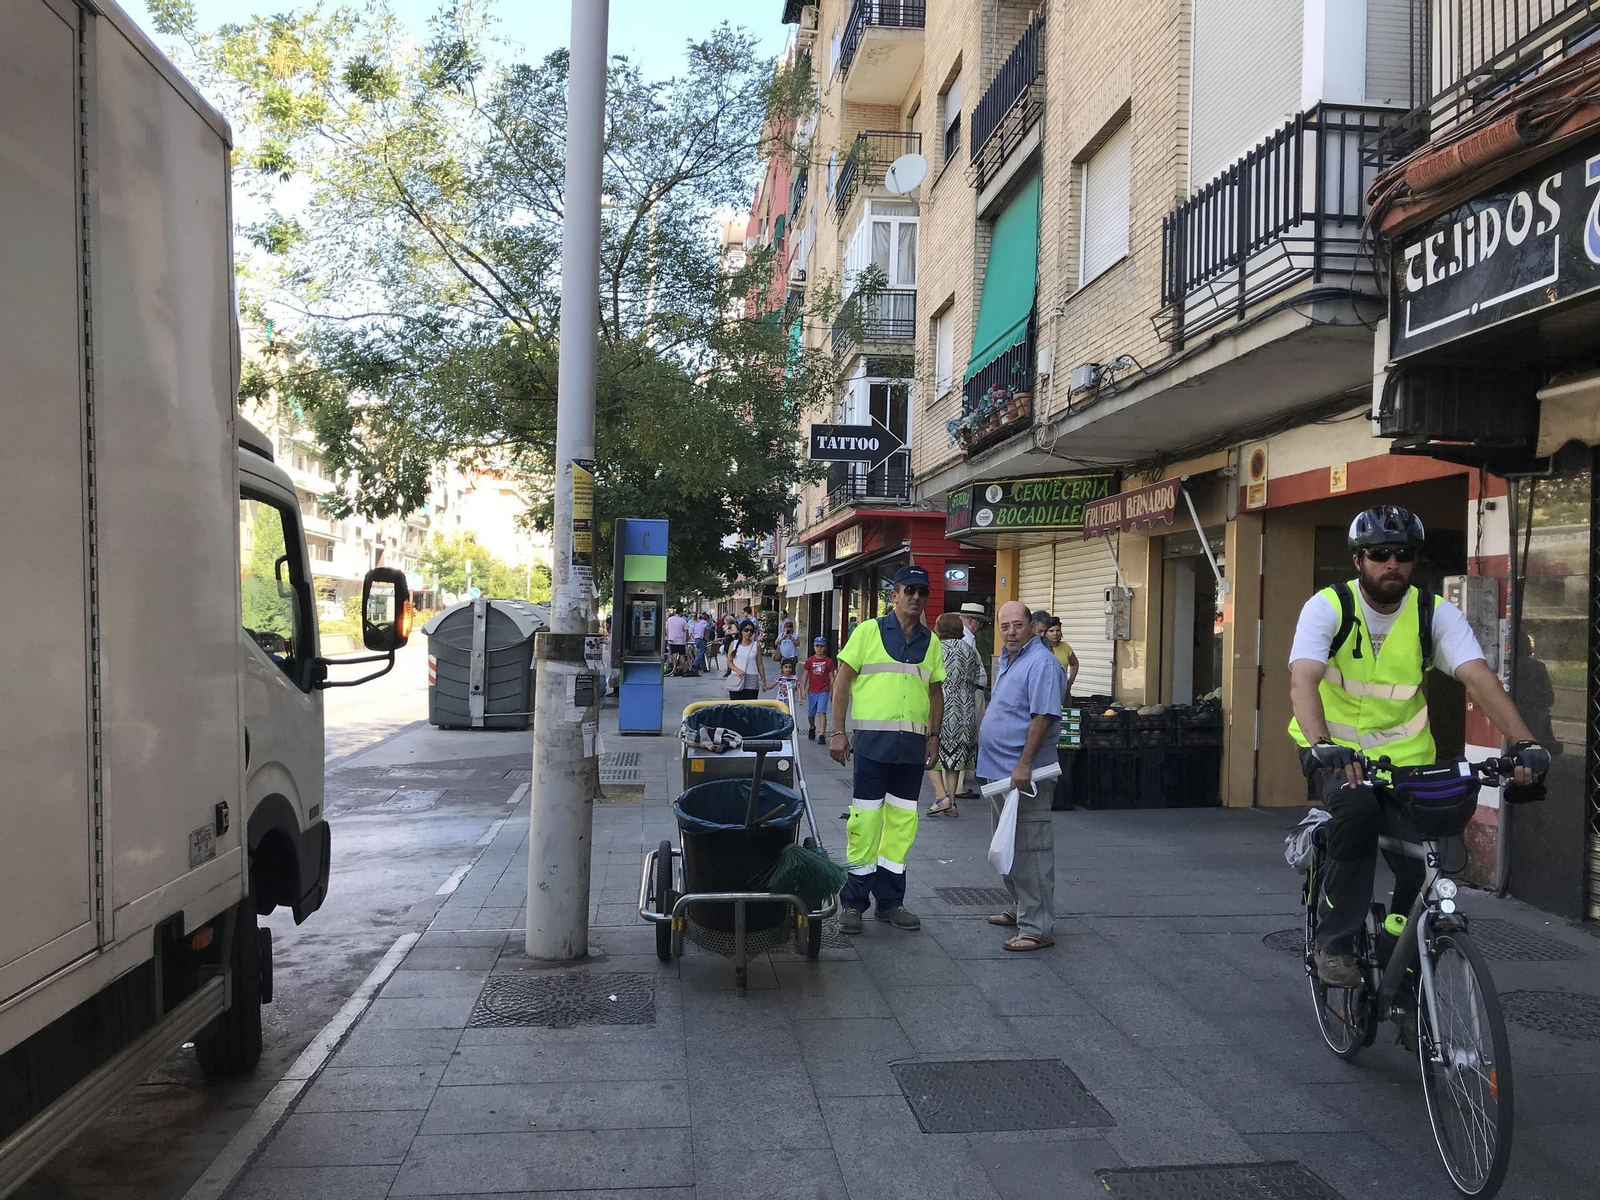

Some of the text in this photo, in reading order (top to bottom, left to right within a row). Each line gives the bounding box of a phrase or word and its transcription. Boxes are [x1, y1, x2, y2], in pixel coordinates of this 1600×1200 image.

[817, 436, 880, 451] TATTOO
[1014, 480, 1108, 502] CERVECERIA
[1084, 485, 1175, 528] FRUTERIA BERNARDO
